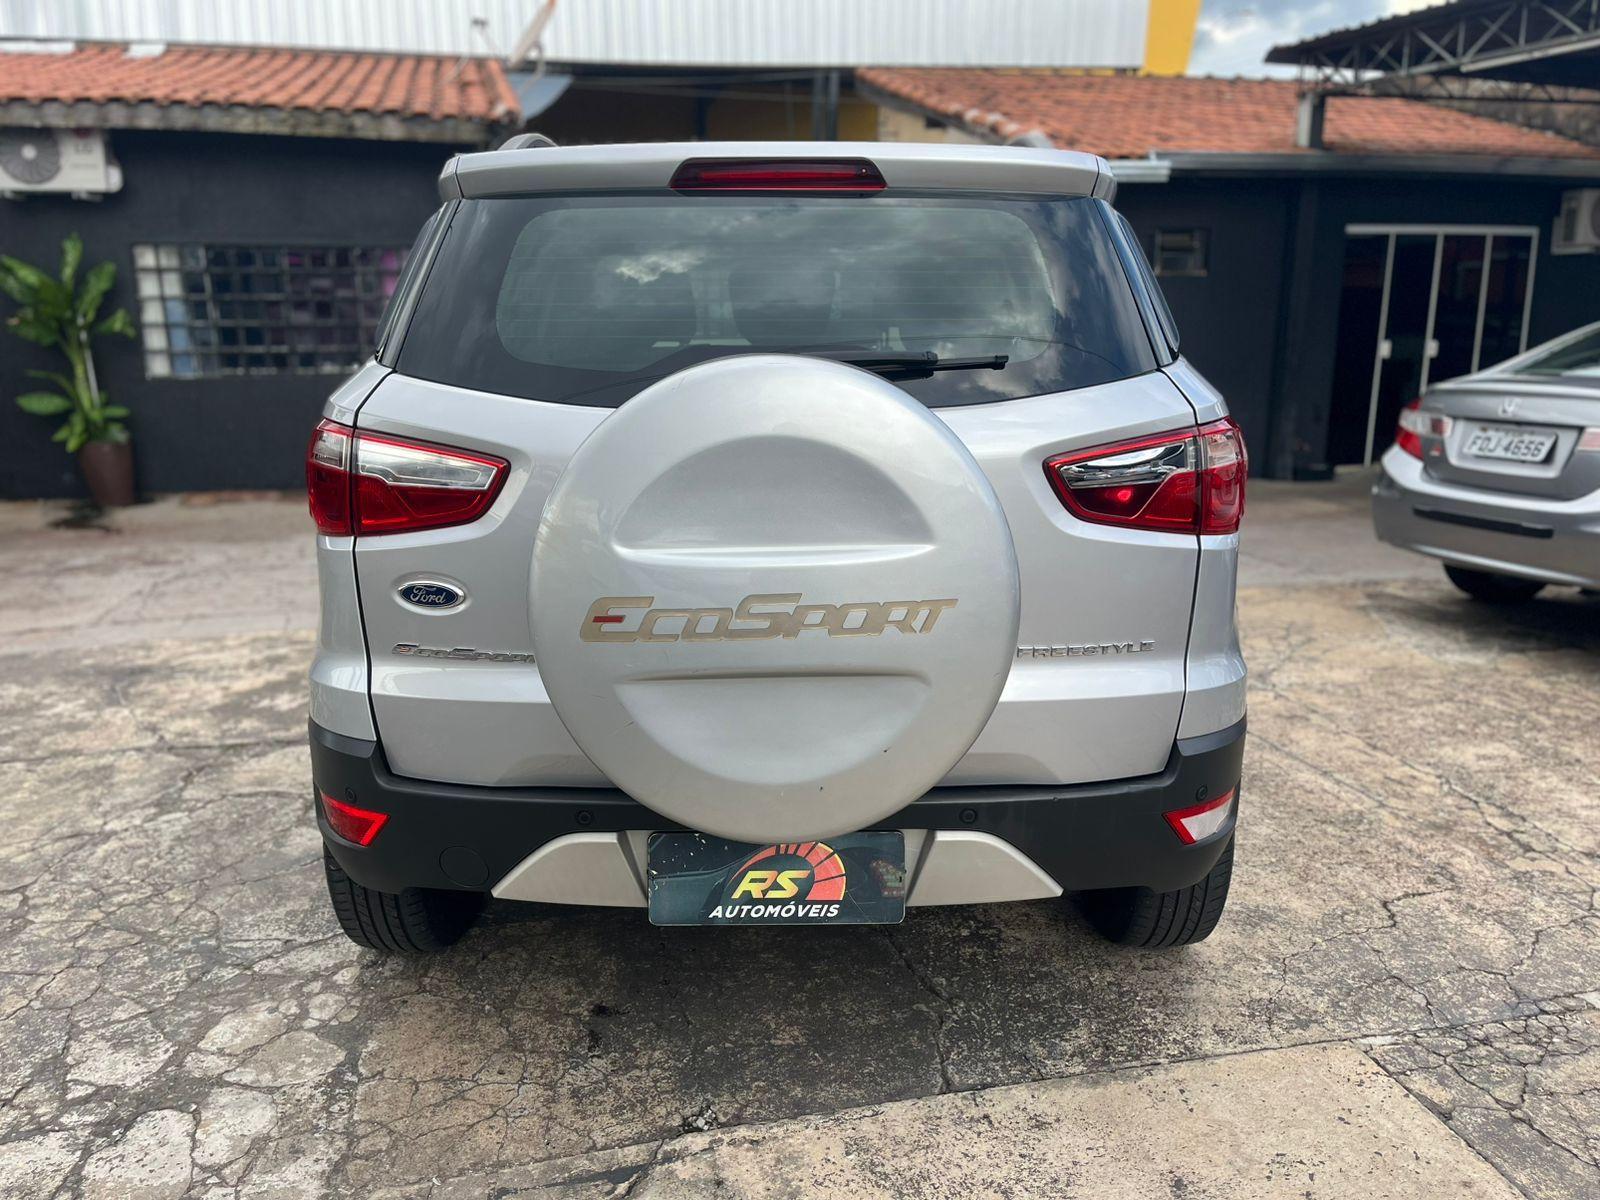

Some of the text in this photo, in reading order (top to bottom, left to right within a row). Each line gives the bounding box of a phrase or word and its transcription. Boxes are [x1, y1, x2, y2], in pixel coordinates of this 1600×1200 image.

[410, 585, 446, 604] Ford
[1016, 640, 1155, 658] FREESTYLE
[731, 870, 811, 899] RS
[708, 901, 840, 918] AUTOMÓVEIS
